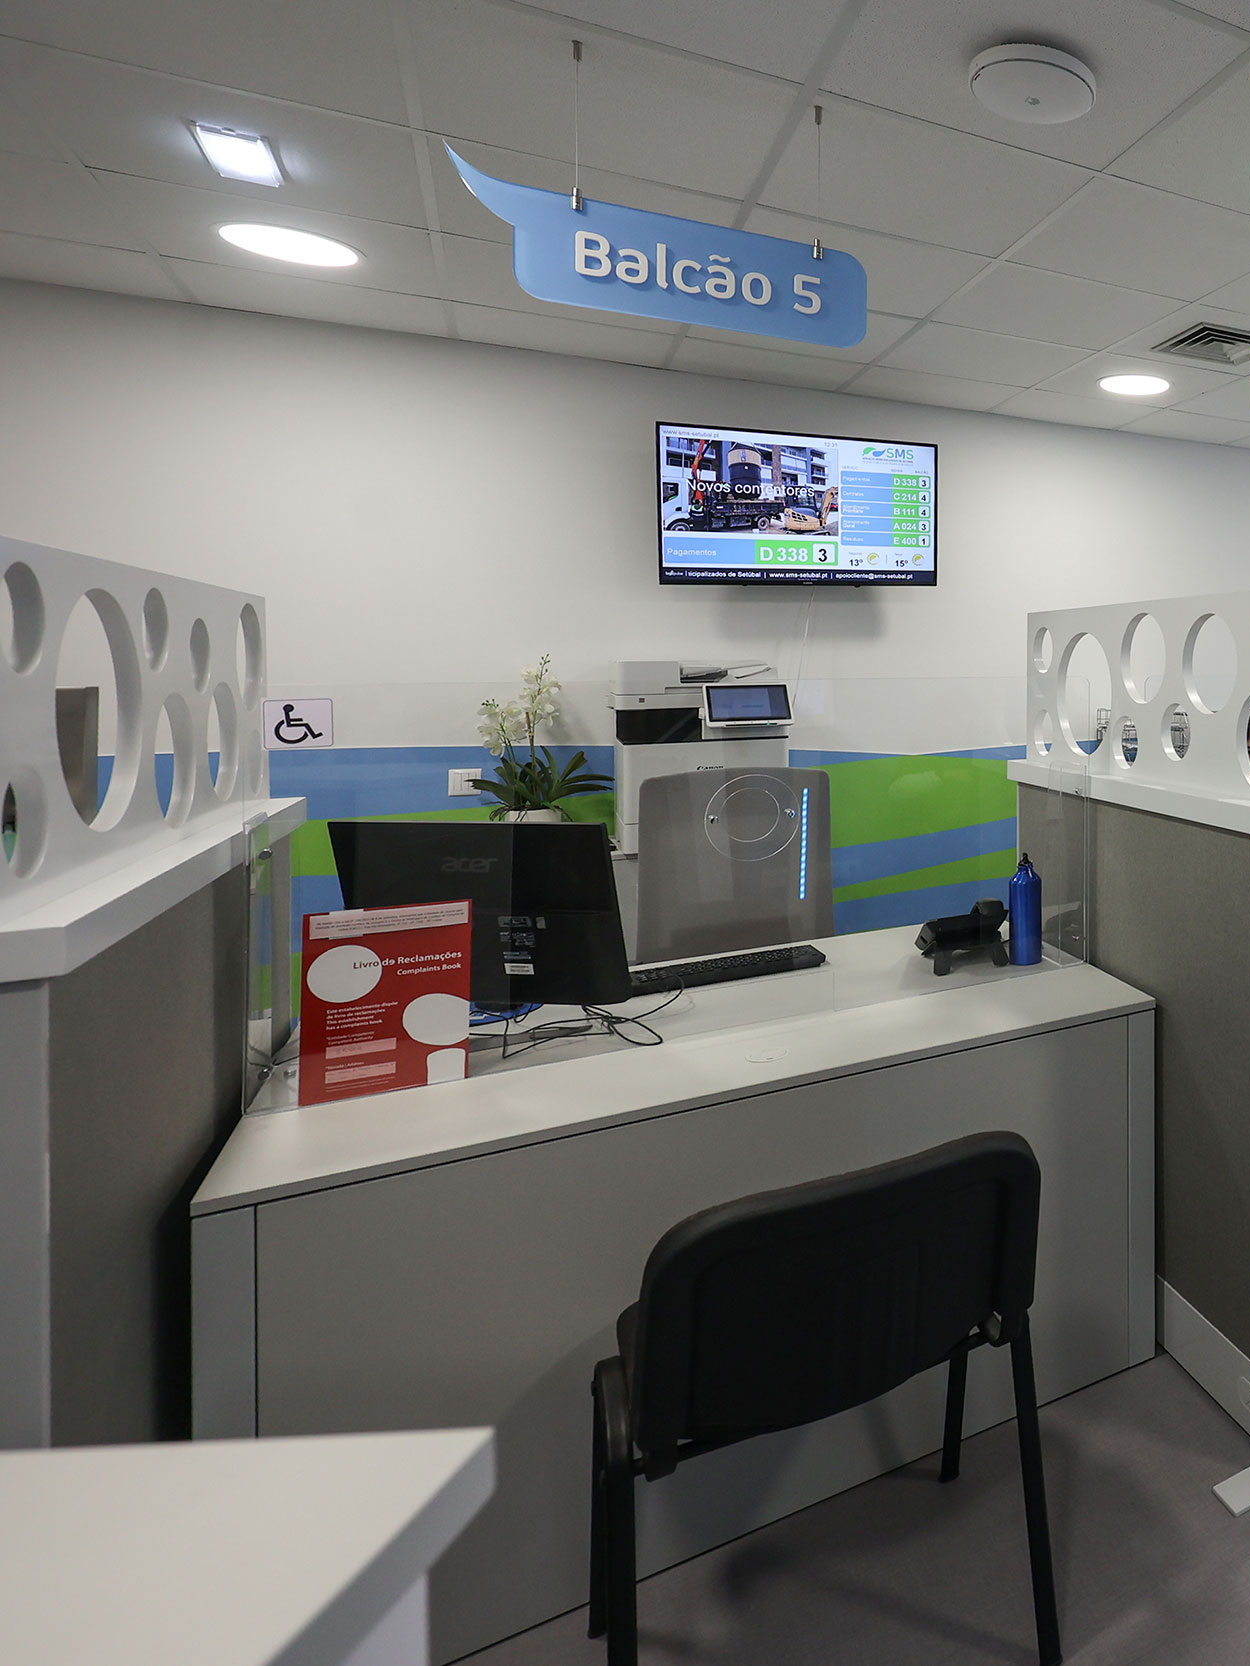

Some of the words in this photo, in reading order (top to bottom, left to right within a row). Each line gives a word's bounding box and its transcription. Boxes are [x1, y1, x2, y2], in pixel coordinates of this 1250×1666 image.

[574, 230, 773, 307] Balcão
[793, 274, 822, 315] 5
[886, 447, 914, 460] SMS
[893, 478, 900, 486] D
[686, 479, 731, 493] Novos
[735, 484, 815, 497] contentores
[902, 493, 917, 501] 214
[921, 494, 927, 502] 4
[902, 508, 916, 516] 111
[893, 522, 900, 530] A
[902, 522, 917, 530] 024
[921, 523, 927, 531] 3
[902, 537, 917, 545] 400
[667, 547, 717, 558] Pagamentos
[760, 547, 774, 561] D
[777, 548, 808, 562] 338
[818, 548, 828, 562] 3
[688, 570, 727, 578] icipalizados
[737, 570, 761, 578] Setúbal
[768, 571, 828, 579] www.sms-setubal.pt
[441, 857, 498, 873] acer
[353, 960, 380, 969] Livro
[381, 958, 396, 966] de
[397, 951, 462, 965] Reclamações
[397, 965, 441, 976] Complaints
